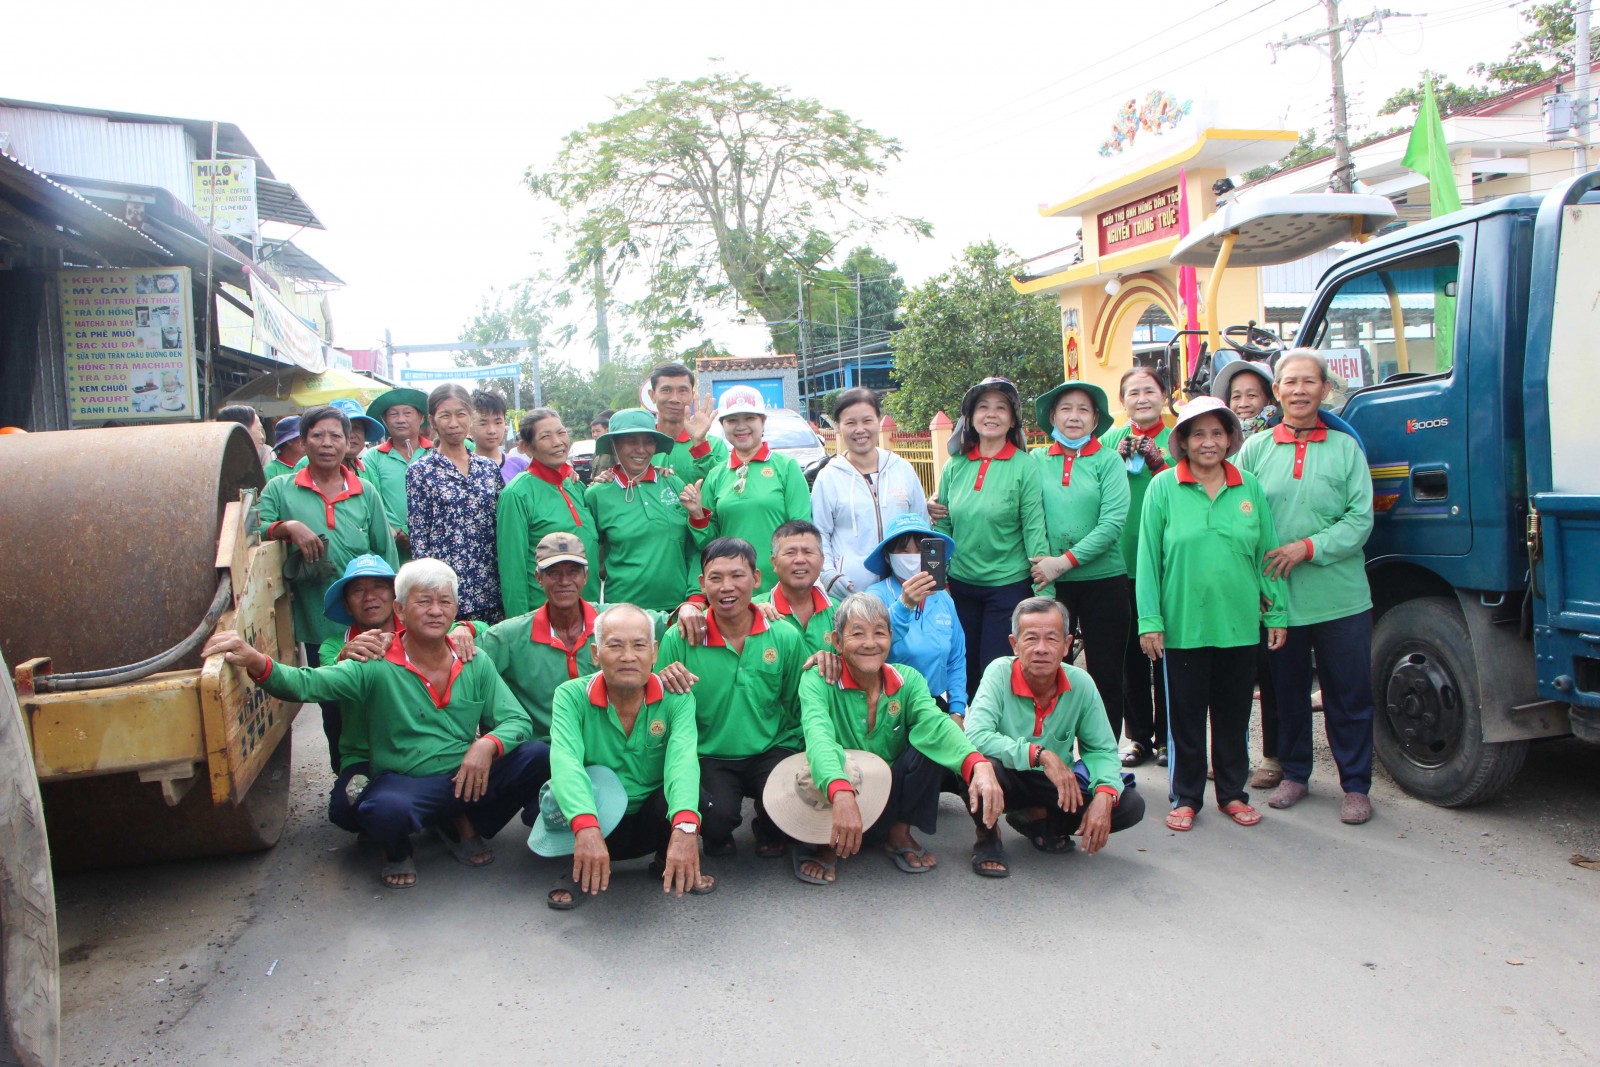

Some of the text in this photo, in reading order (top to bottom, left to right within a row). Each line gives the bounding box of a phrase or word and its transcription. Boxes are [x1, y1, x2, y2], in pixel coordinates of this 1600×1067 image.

[1133, 217, 1155, 236] TRUNG
[90, 330, 108, 338] PHÊ
[76, 342, 97, 350] BẠC
[80, 395, 130, 403] YAOURT
[1406, 417, 1449, 434] K3000S
